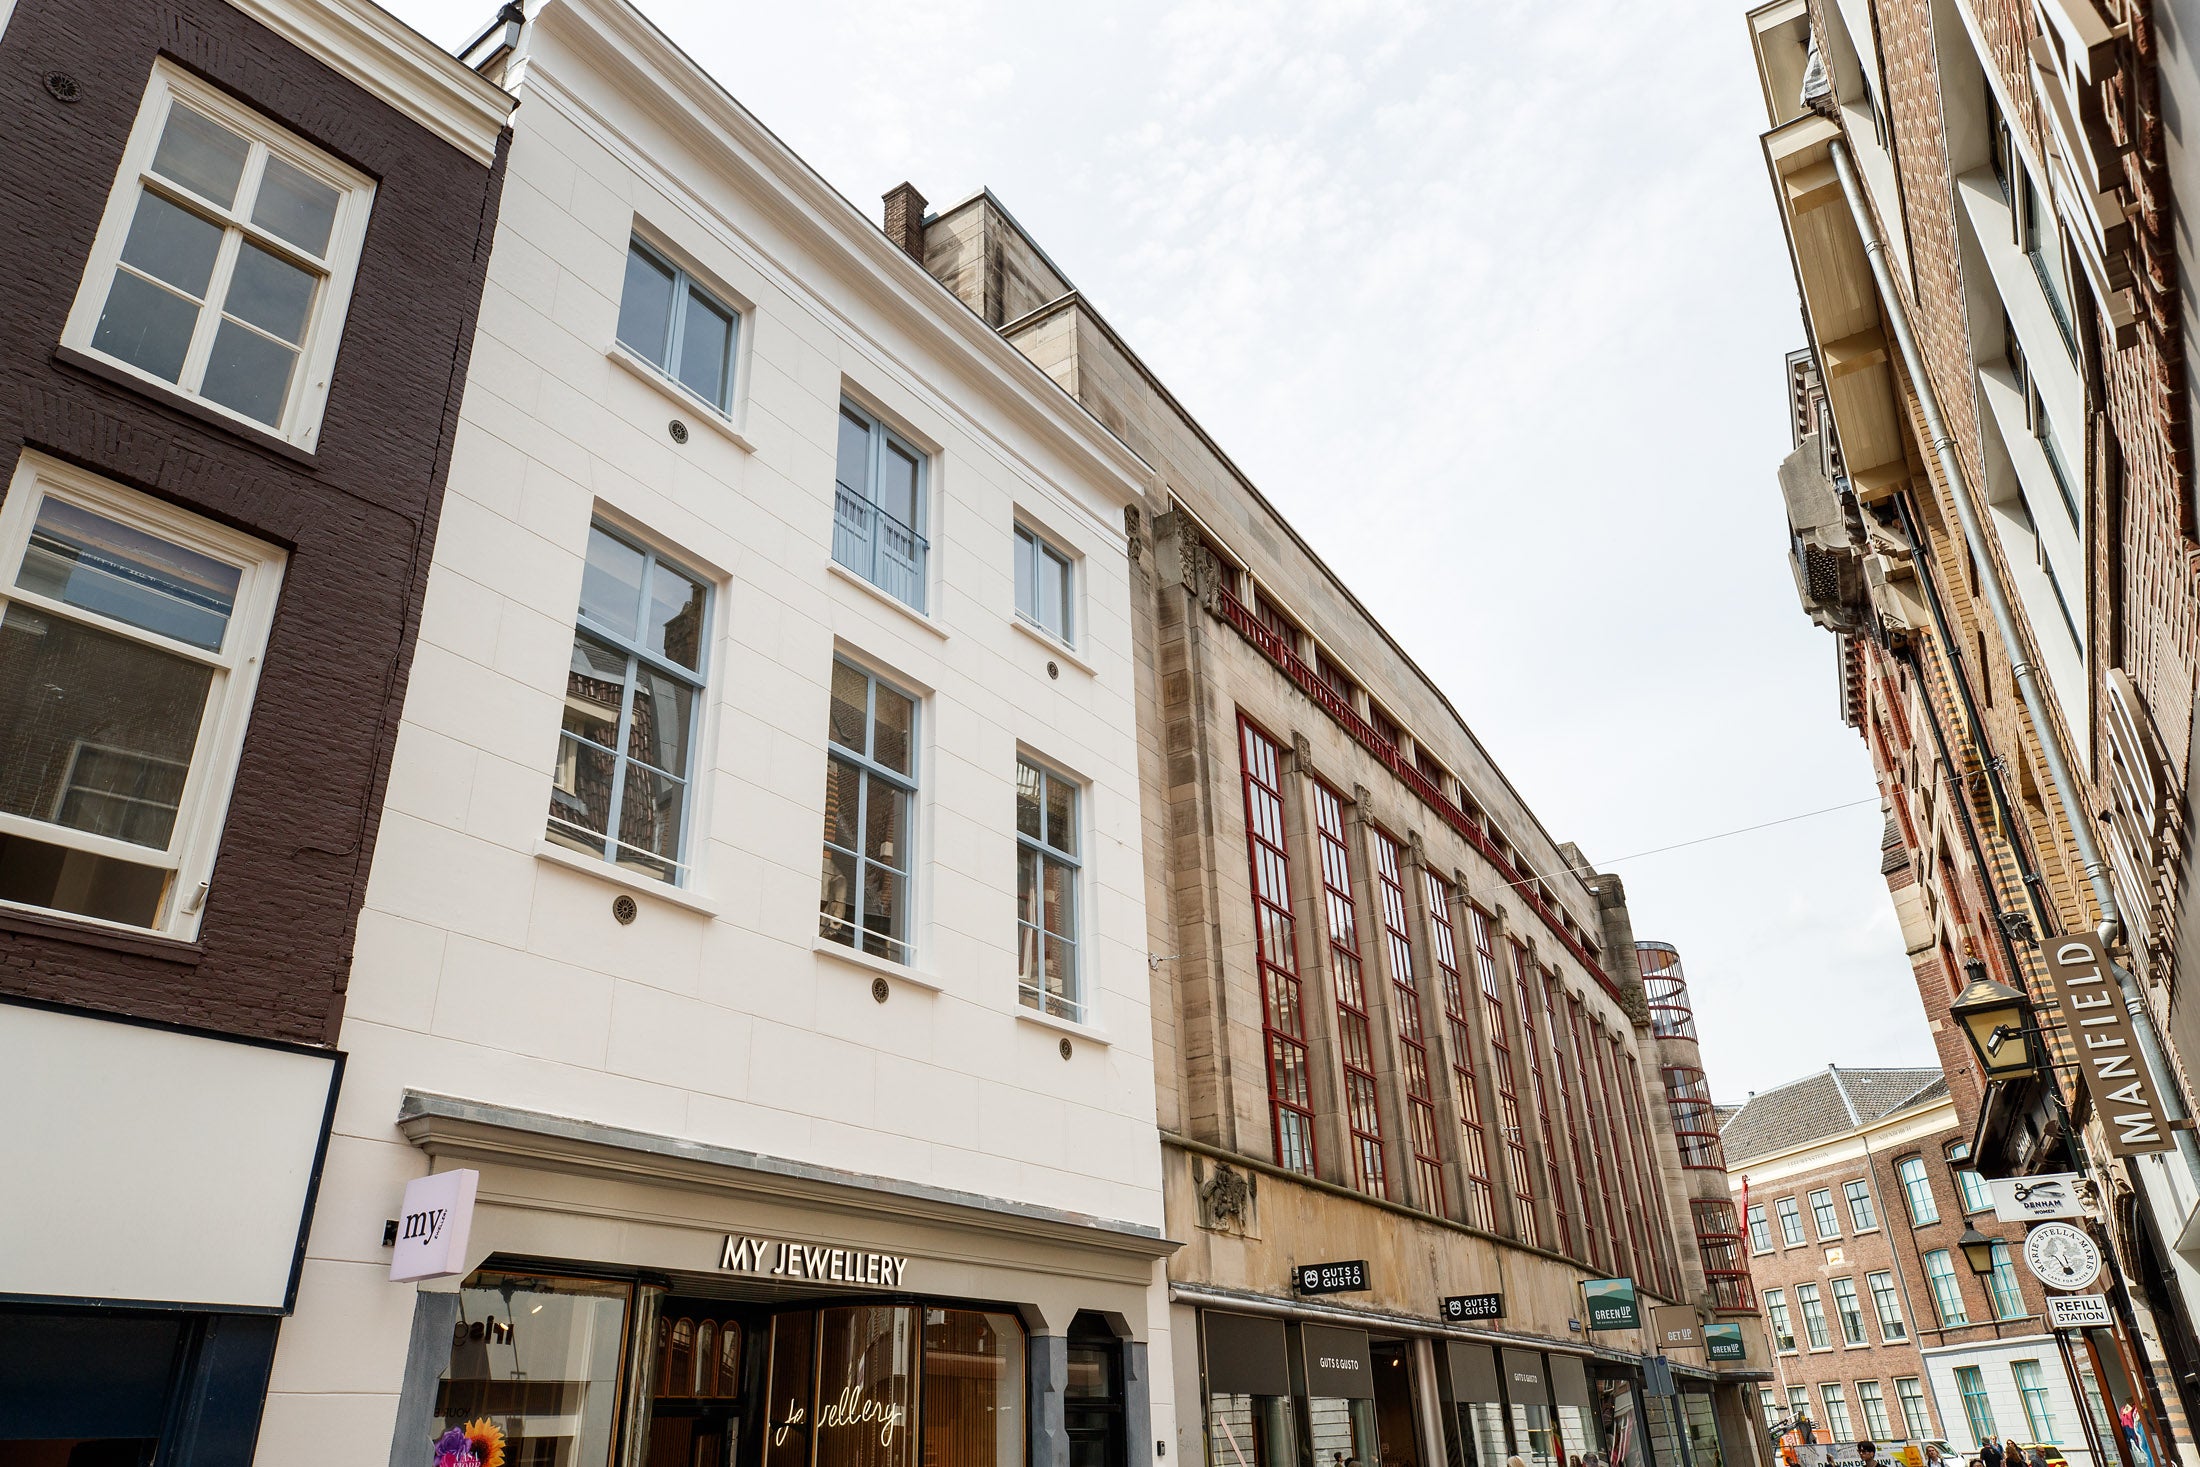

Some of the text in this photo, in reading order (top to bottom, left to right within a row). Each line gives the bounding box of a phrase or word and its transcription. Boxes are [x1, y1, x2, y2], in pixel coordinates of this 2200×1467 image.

[2057, 942, 2161, 1144] MANFIELD
[2023, 1199, 2062, 1209] DENHAM
[402, 1208, 444, 1246] my
[721, 1234, 908, 1286] MY JEWELLERY
[1322, 1265, 1361, 1278] GUTS &
[1322, 1275, 1361, 1288] GUSTO
[1464, 1297, 1497, 1308] GUTS &
[2055, 1299, 2102, 1312] REFILL
[1465, 1305, 1497, 1316] GUSTO
[2058, 1311, 2105, 1322] STATION
[1667, 1328, 1692, 1341] GET UP
[1320, 1357, 1335, 1368] GUTS
[1340, 1359, 1359, 1370] GUSTO
